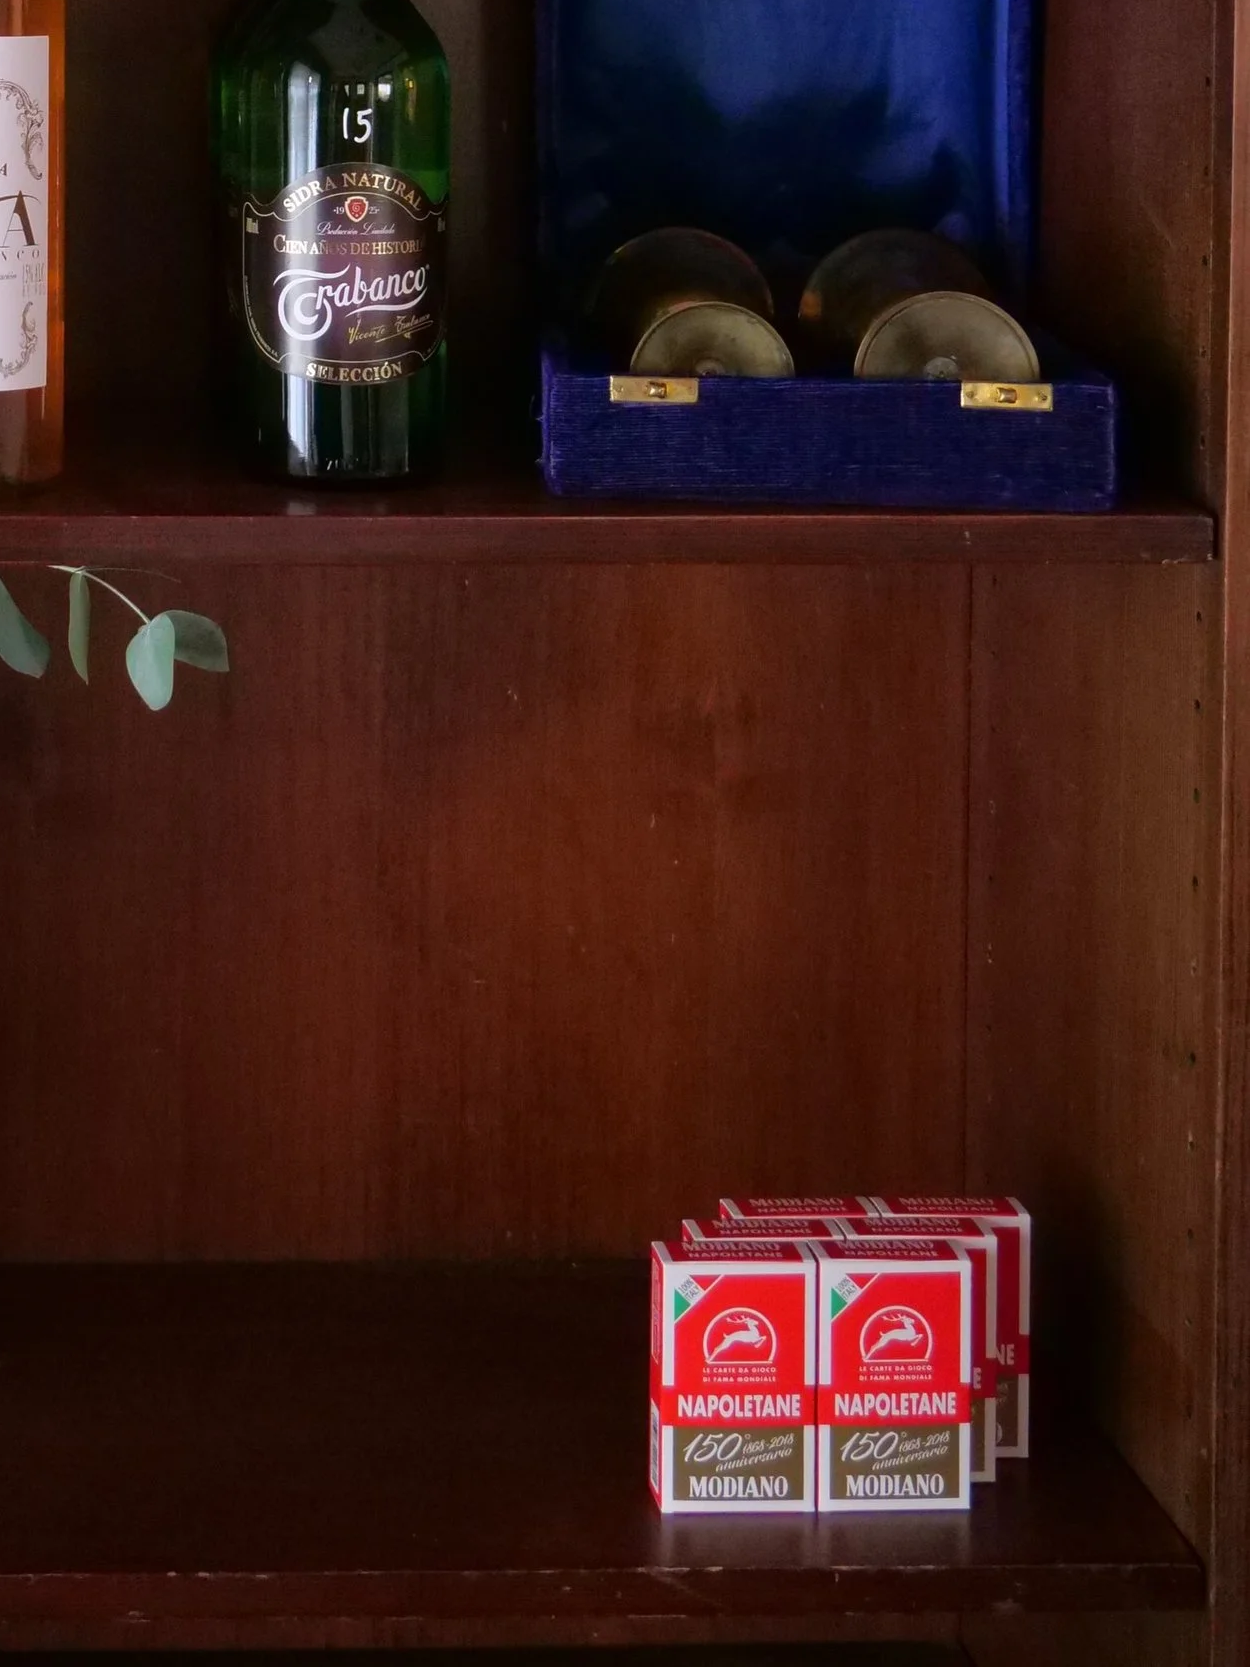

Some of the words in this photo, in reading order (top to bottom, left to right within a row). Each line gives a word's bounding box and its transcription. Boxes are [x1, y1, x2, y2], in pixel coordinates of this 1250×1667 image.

[342, 107, 373, 144] 15
[283, 176, 337, 213] SIDRA
[340, 172, 423, 212] NATURAL
[316, 220, 359, 235] Producción
[273, 234, 308, 255] CIEN
[350, 241, 371, 255] DE
[273, 263, 428, 342] Trabanco
[306, 360, 404, 382] SELECCIÓN
[749, 1198, 845, 1207] MODIANO
[899, 1197, 994, 1206] MODIANO
[712, 1219, 809, 1229] MODIANO
[864, 1218, 960, 1227] MODIANO
[681, 1241, 781, 1252] MODIANO
[837, 1240, 934, 1250] MODIANO
[677, 1394, 800, 1418] NAPOLETANE
[834, 1392, 956, 1416] NAPOLETANE
[715, 1447, 792, 1472] anniversario
[872, 1445, 949, 1471] anniversario
[688, 1475, 789, 1499] MODIANO
[846, 1473, 945, 1497] MODIANO
